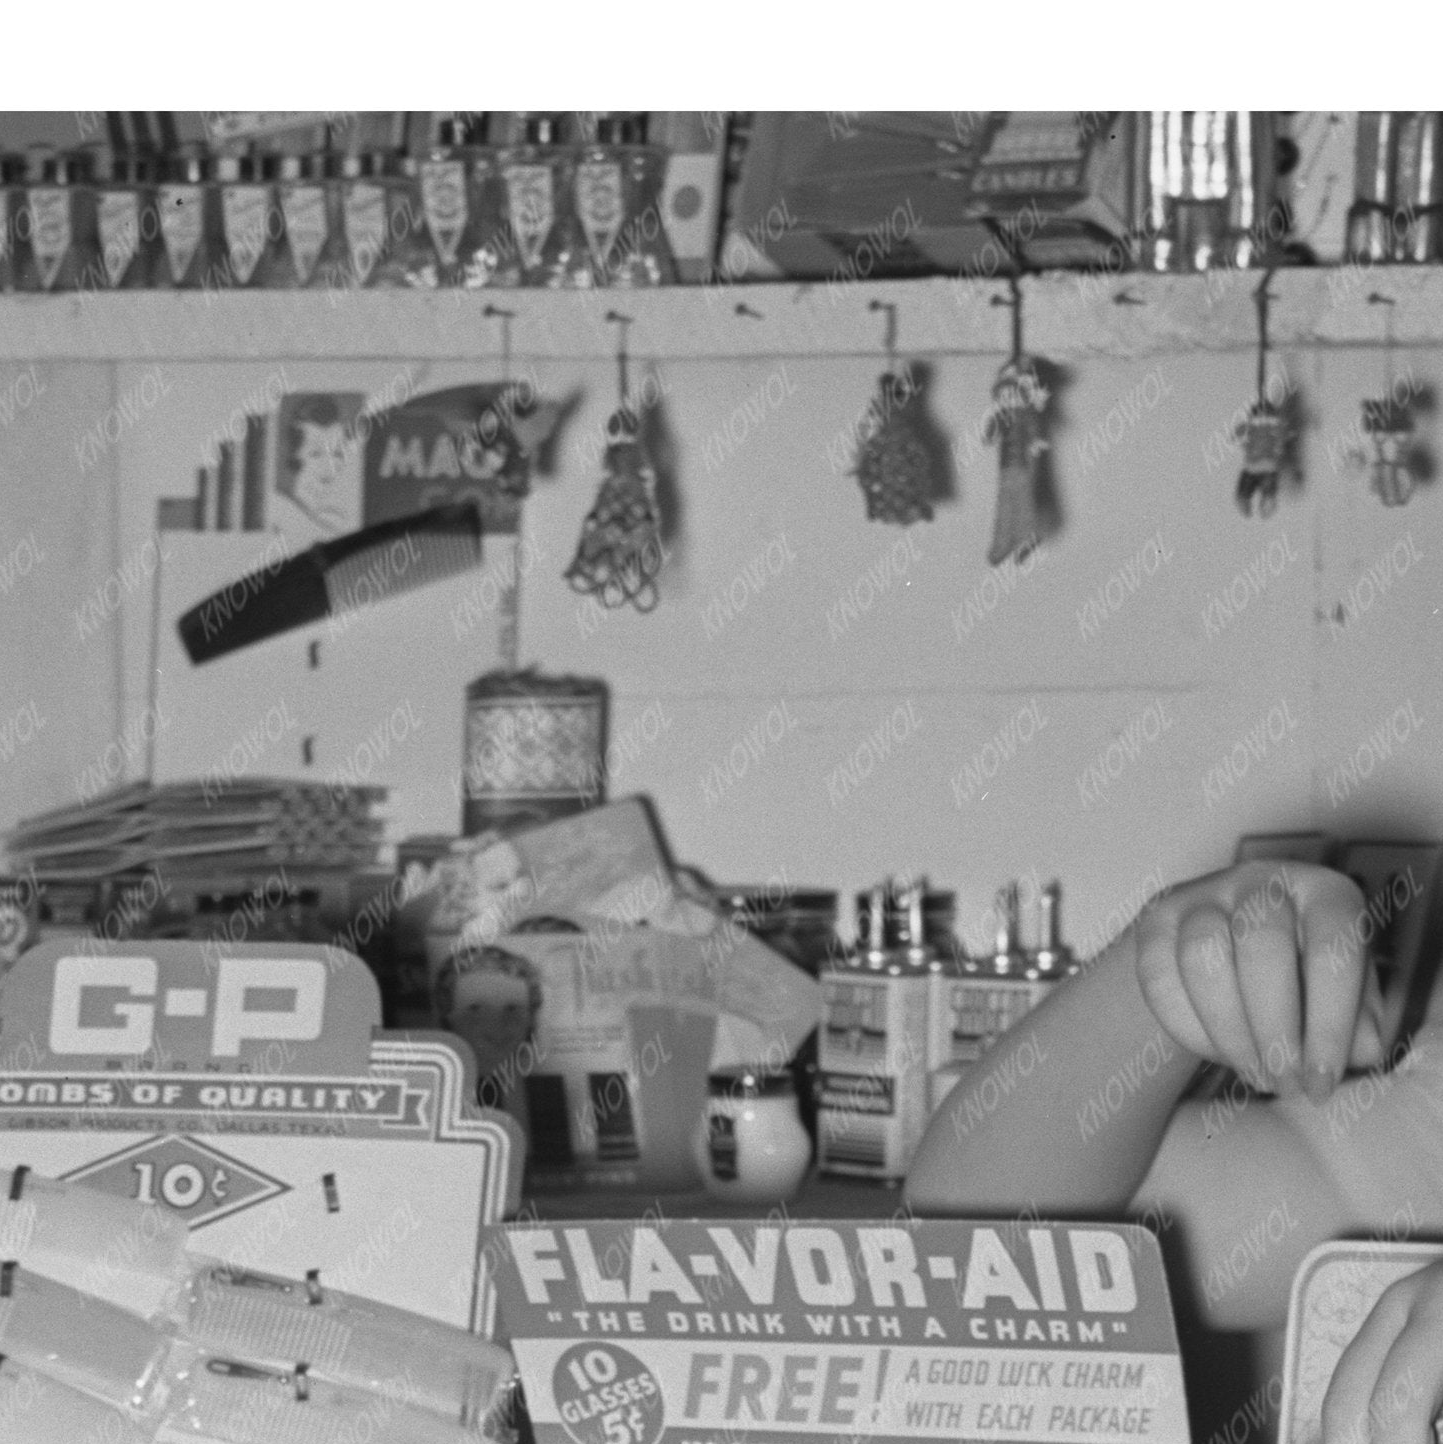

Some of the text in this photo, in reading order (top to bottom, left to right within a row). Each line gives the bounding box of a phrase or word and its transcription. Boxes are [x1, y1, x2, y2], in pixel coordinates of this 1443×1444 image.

[48, 955, 328, 1058] G-P
[131, 1084, 183, 1104] OF
[198, 1086, 387, 1110] QUALITY
[508, 1227, 1139, 1314] FLA-VOR-AID
[668, 1312, 787, 1335] DRINK
[806, 1314, 903, 1337] WITH
[924, 1317, 947, 1337] A
[567, 1348, 618, 1392] 10
[905, 1358, 1145, 1389] A GOOD LUCK CHARM
[562, 1372, 659, 1425] GLASSES
[905, 1401, 1153, 1434] WITH EACH PACKAGE
